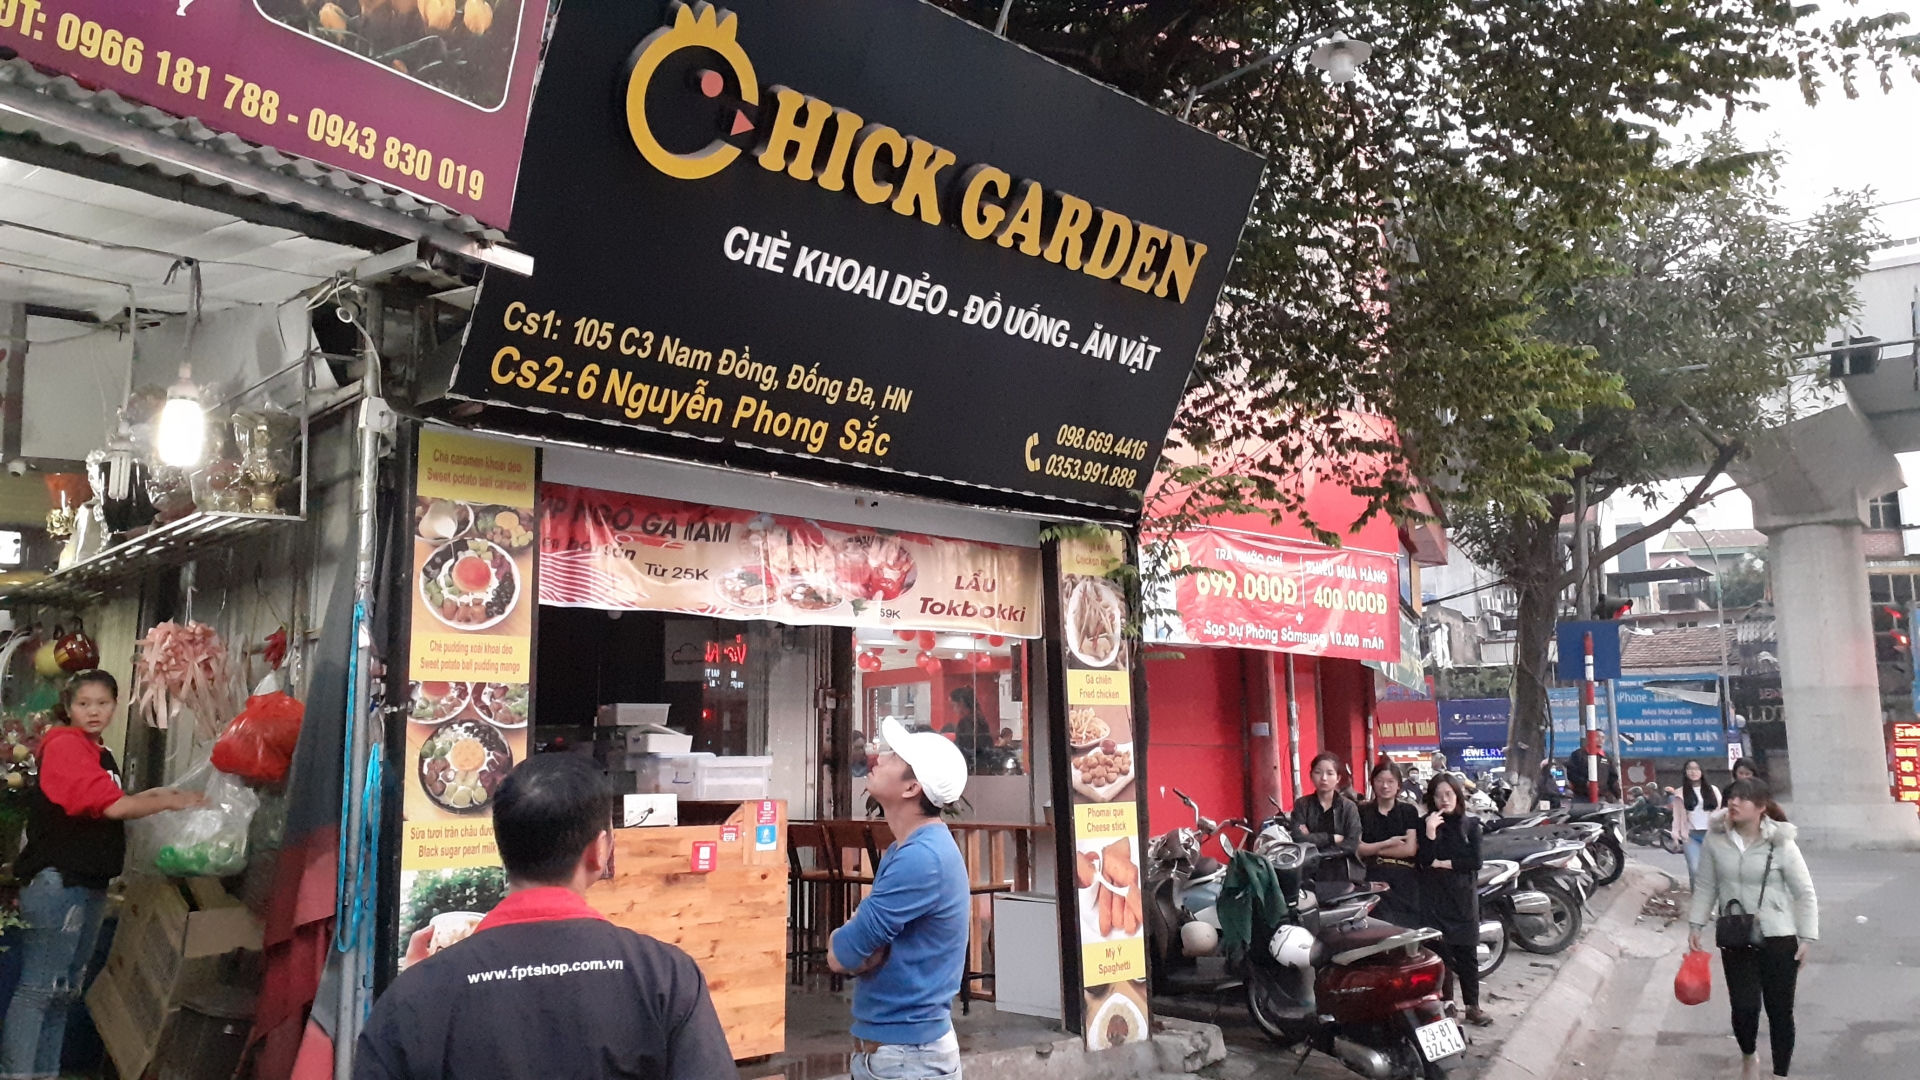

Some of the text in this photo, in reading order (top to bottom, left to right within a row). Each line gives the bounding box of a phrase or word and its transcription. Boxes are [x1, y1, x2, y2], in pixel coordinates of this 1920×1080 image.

[56, 13, 145, 75] 0966
[156, 50, 211, 100] 181
[223, 73, 280, 125] 788
[307, 107, 378, 160] 0943
[383, 135, 433, 183] 830
[437, 157, 485, 201] 019
[960, 165, 1208, 304] GARDEN
[723, 226, 791, 274] CHÈ
[792, 244, 888, 300] KHOAI
[888, 271, 947, 317] DẺO
[963, 290, 1004, 330] ĐỒ
[1003, 305, 1071, 351] UỐNG
[1082, 322, 1118, 361] ĂN
[1117, 333, 1162, 375] VẶT
[502, 301, 914, 414] Cs1: 105 C3 Nam Đồng, Đống Đa, HN
[601, 366, 724, 425] Nguyễn
[731, 395, 831, 454] Phong
[839, 413, 893, 457] Sắc
[1056, 423, 1148, 461] 098.669.4416
[427, 467, 451, 481] Sweet
[453, 472, 478, 487] potato
[1045, 453, 1138, 489] 0353.991.888
[644, 562, 709, 581] Từ 25K
[954, 568, 996, 593] LẨU
[1336, 564, 1357, 580] MUA
[1360, 565, 1388, 584] HÀNG
[1196, 570, 1298, 606] 699.000Đ
[1313, 585, 1388, 615] 400.000Đ
[919, 596, 1026, 623] Tokbokki
[1204, 620, 1226, 639] Sạc
[1228, 622, 1243, 641] Dự
[1245, 623, 1279, 644] Phòng
[1329, 631, 1360, 648] 10.000
[1362, 635, 1385, 650] mAh
[443, 641, 469, 656] pudding
[484, 641, 501, 654] khoai
[420, 657, 520, 675] Sweet potato ball pudding mango
[1079, 688, 1120, 699] Fried chicken
[1617, 692, 1647, 703] iPhone
[1461, 748, 1502, 757] JEWELRY
[1087, 807, 1124, 819] Phomai que
[1086, 821, 1127, 833] Cheese stick
[418, 841, 497, 859] Black sugar pearl milk
[467, 959, 624, 984] www.fptshop.com.vn
[1098, 960, 1131, 975] Spaghetti
[1422, 1022, 1453, 1044] 29-B1
[1425, 1036, 1462, 1060] 324.14
